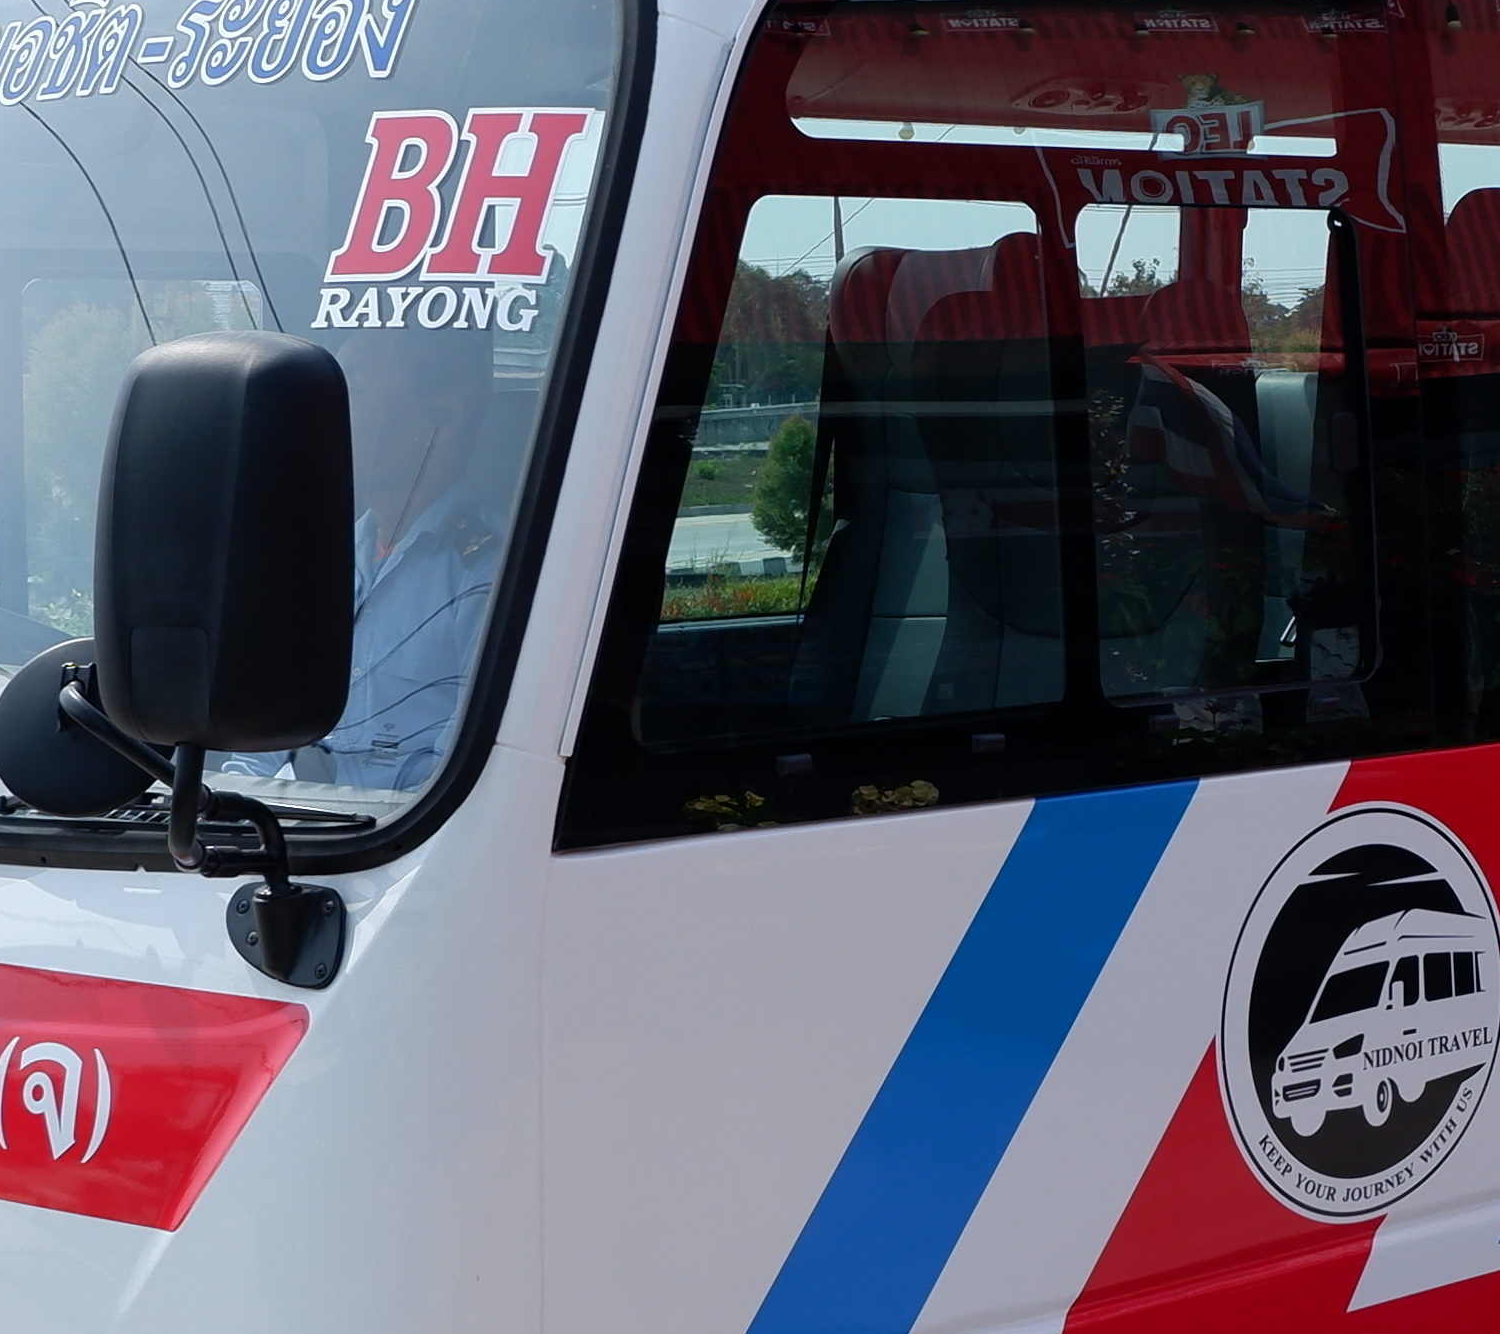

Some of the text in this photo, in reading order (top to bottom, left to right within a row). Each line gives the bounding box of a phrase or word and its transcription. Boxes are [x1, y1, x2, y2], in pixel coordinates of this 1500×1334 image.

[324, 108, 596, 284] BH
[311, 286, 538, 332] RAYONG
[1362, 1026, 1493, 1071] NIDNOI TRAVEL
[1257, 1085, 1475, 1203] KEEP YOUR JOURNEY WITH US
